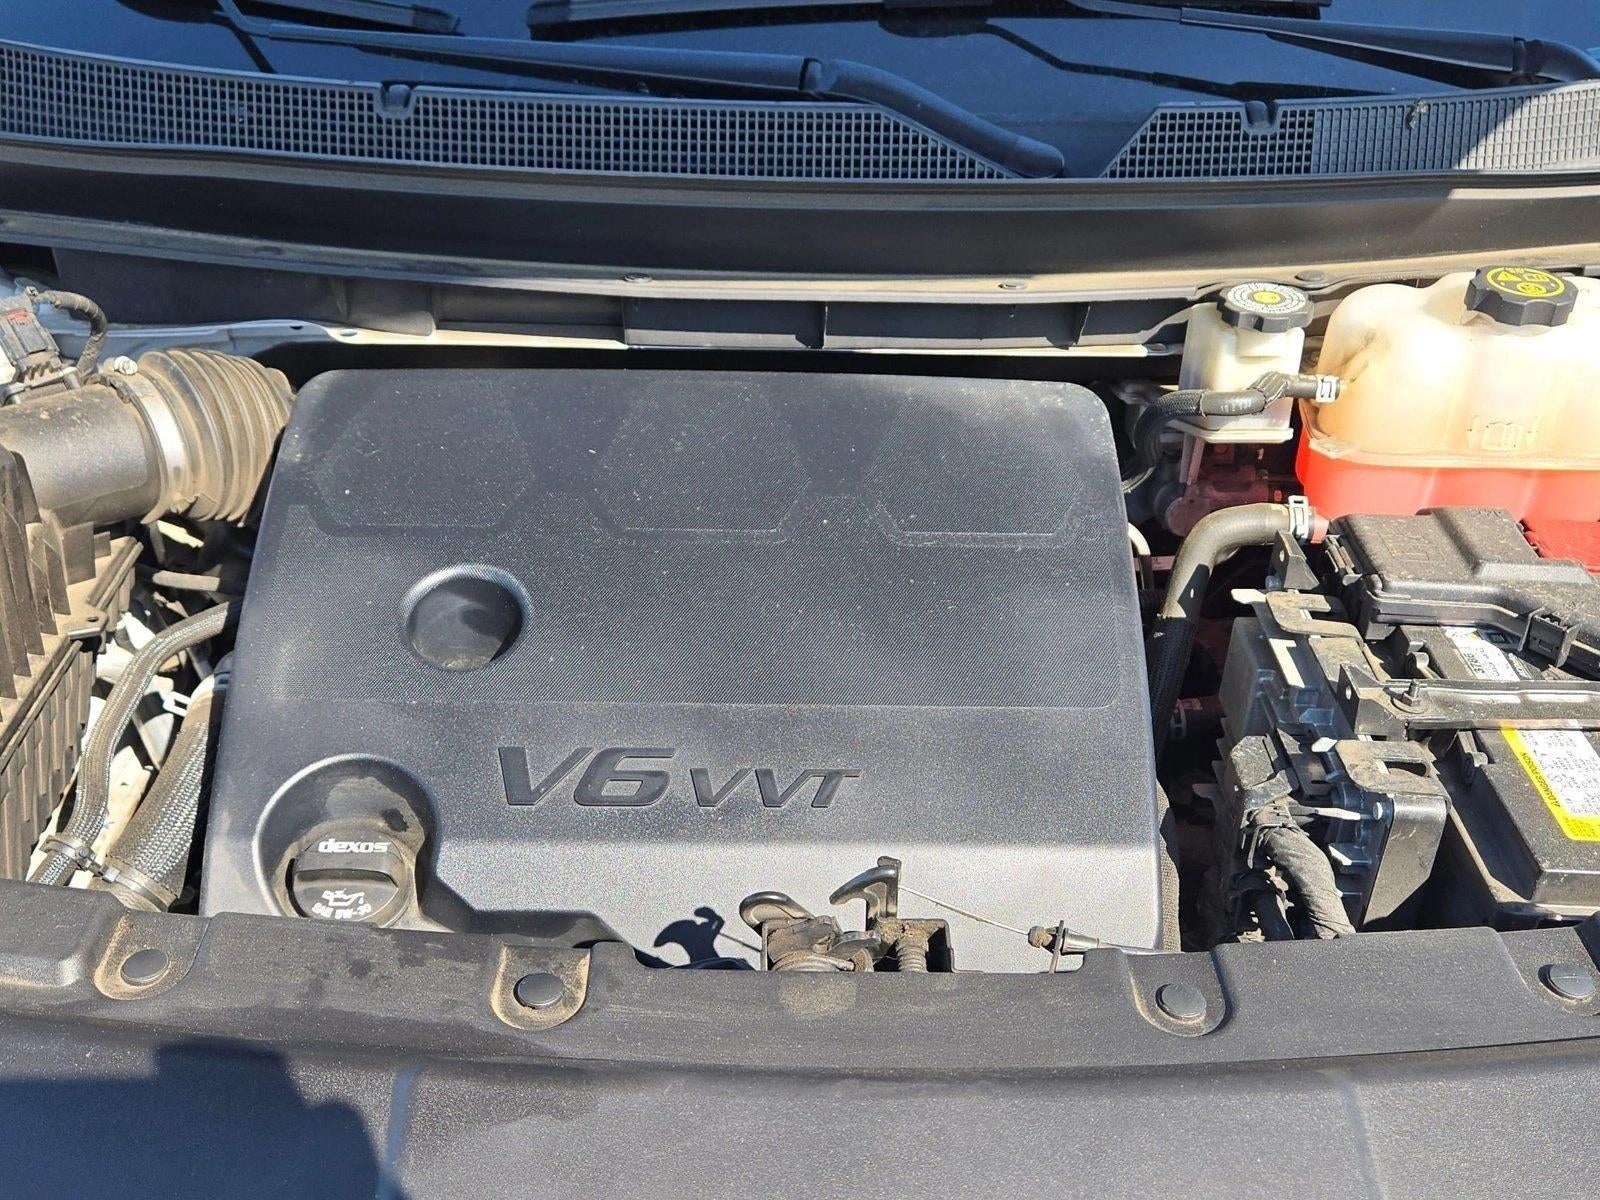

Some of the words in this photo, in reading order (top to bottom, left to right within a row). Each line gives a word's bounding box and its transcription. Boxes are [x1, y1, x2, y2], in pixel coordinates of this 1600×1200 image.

[497, 747, 677, 806] V6
[689, 768, 862, 808] VVT
[318, 838, 392, 853] dexos
